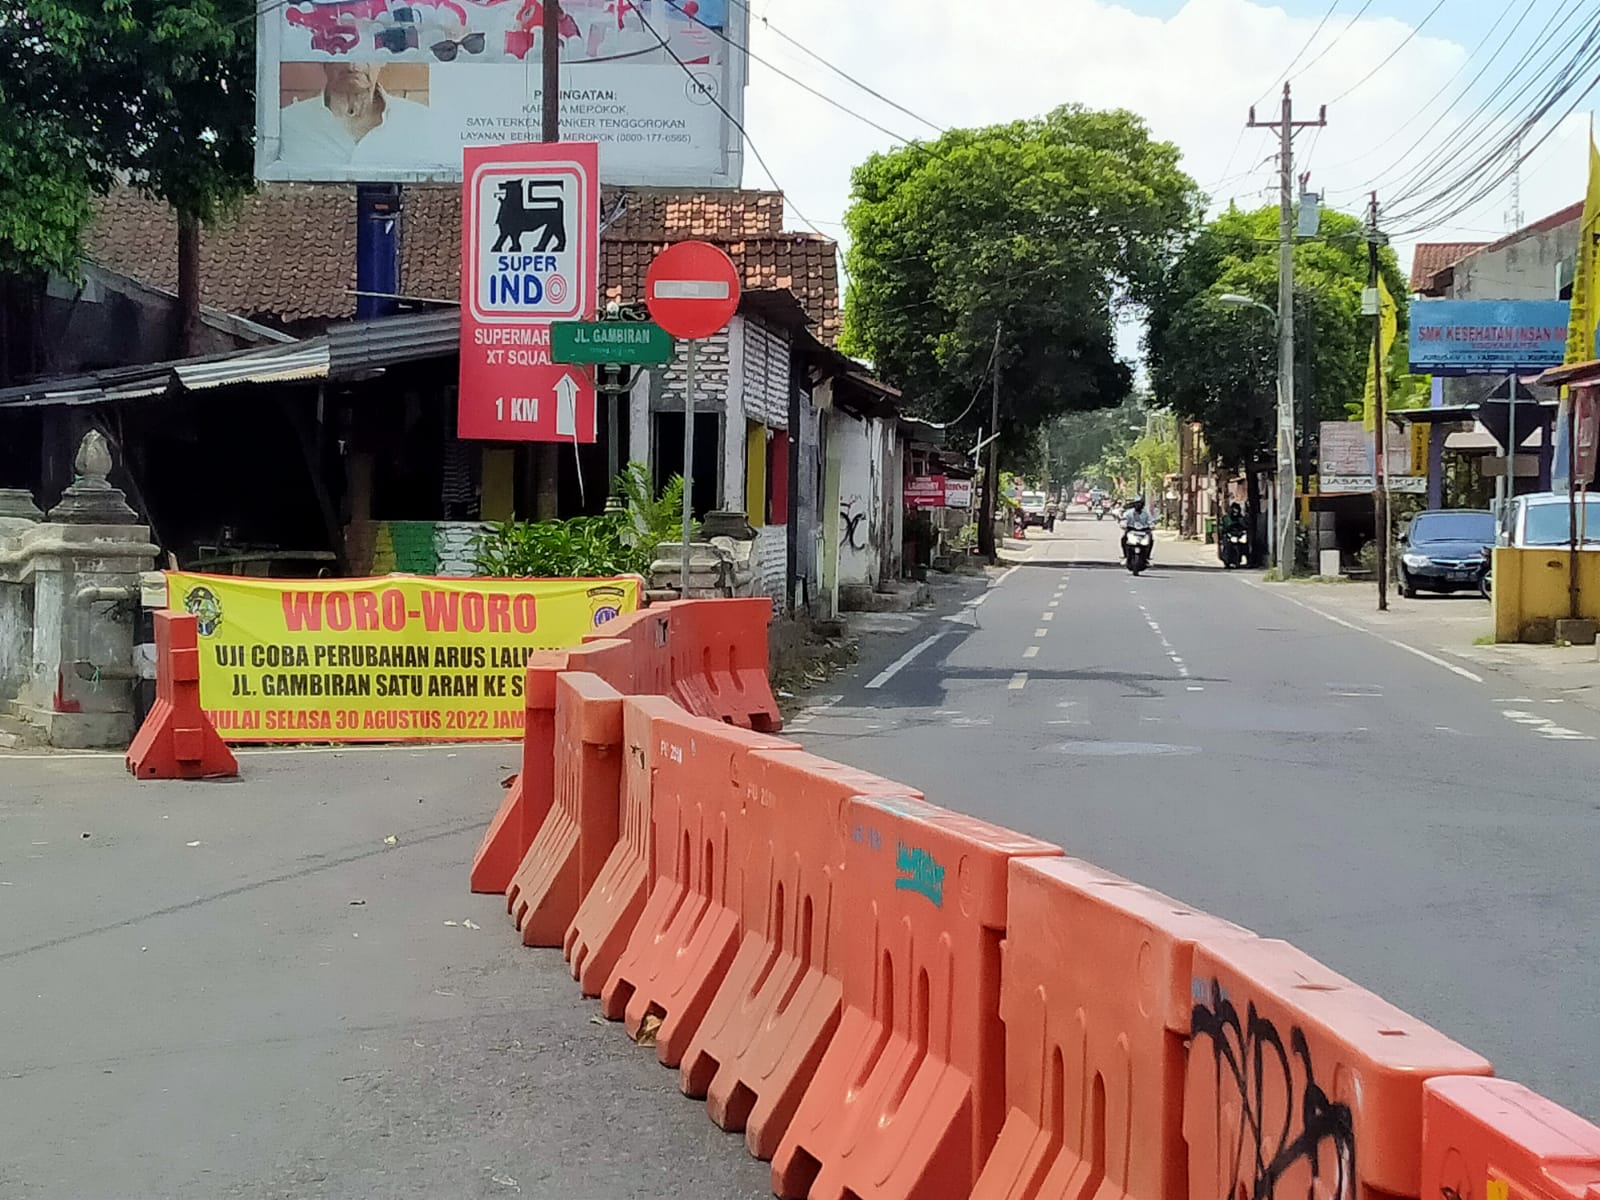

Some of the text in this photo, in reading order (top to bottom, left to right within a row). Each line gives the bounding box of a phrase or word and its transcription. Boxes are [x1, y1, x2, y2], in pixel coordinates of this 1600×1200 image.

[533, 90, 617, 101] PINGATAN:
[466, 118, 686, 129] SAYA TERKEN ANKER TENGGOROKAN
[460, 132, 506, 141] LAYANAN
[563, 133, 615, 142] MEROKOK
[498, 255, 557, 272] SUPER
[490, 274, 568, 305] INDO
[474, 328, 549, 346] SUPERMAR
[574, 328, 650, 345] JL. GAMBIRAN
[1446, 326, 1512, 342] KESEHATAN
[486, 349, 552, 366] XT SQUA
[495, 397, 538, 422] 1 KM
[281, 589, 537, 634] WORO-WORO
[215, 645, 245, 667] UJI
[251, 645, 309, 667] COBA
[315, 645, 429, 668] PERUBAHAN
[434, 646, 486, 668] ARUS
[232, 674, 526, 698] JL. GAMBIRAN SATU ARAH KE S
[265, 710, 332, 729] SELASA
[336, 710, 360, 729] 30
[363, 710, 441, 729] AGUSTUS
[446, 710, 488, 729] 2022
[493, 710, 525, 729] JAM
